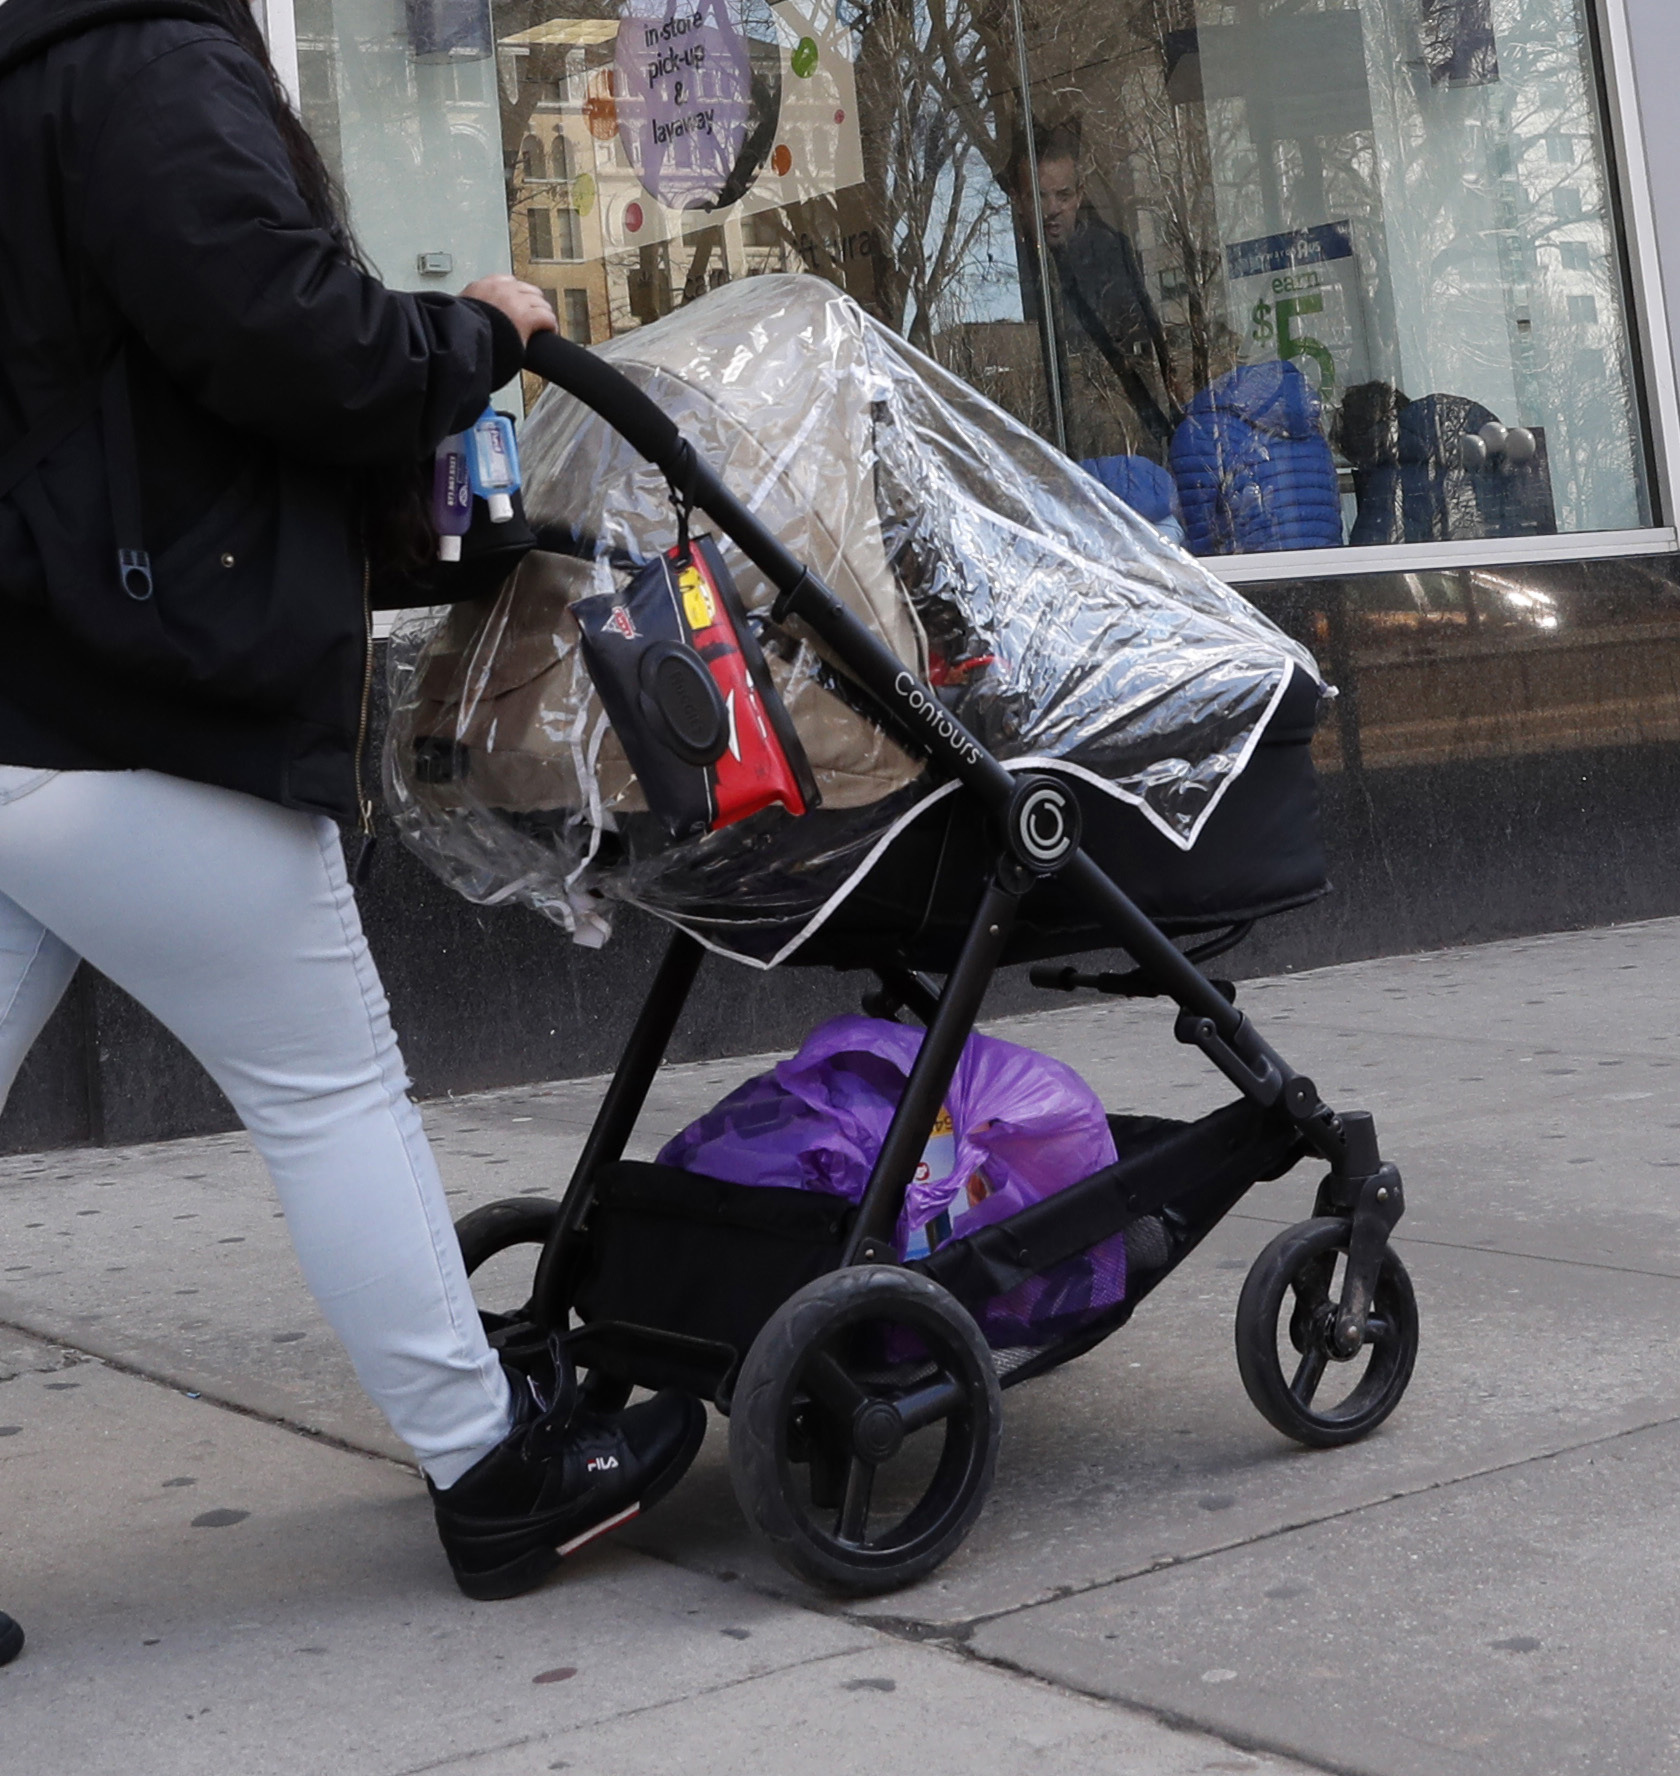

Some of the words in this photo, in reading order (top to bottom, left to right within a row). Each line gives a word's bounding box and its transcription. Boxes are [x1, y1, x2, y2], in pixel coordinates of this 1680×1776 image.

[648, 45, 706, 89] pick-up
[1272, 271, 1320, 293] earn
[895, 671, 982, 764] Contours
[587, 1455, 619, 1472] FILA
